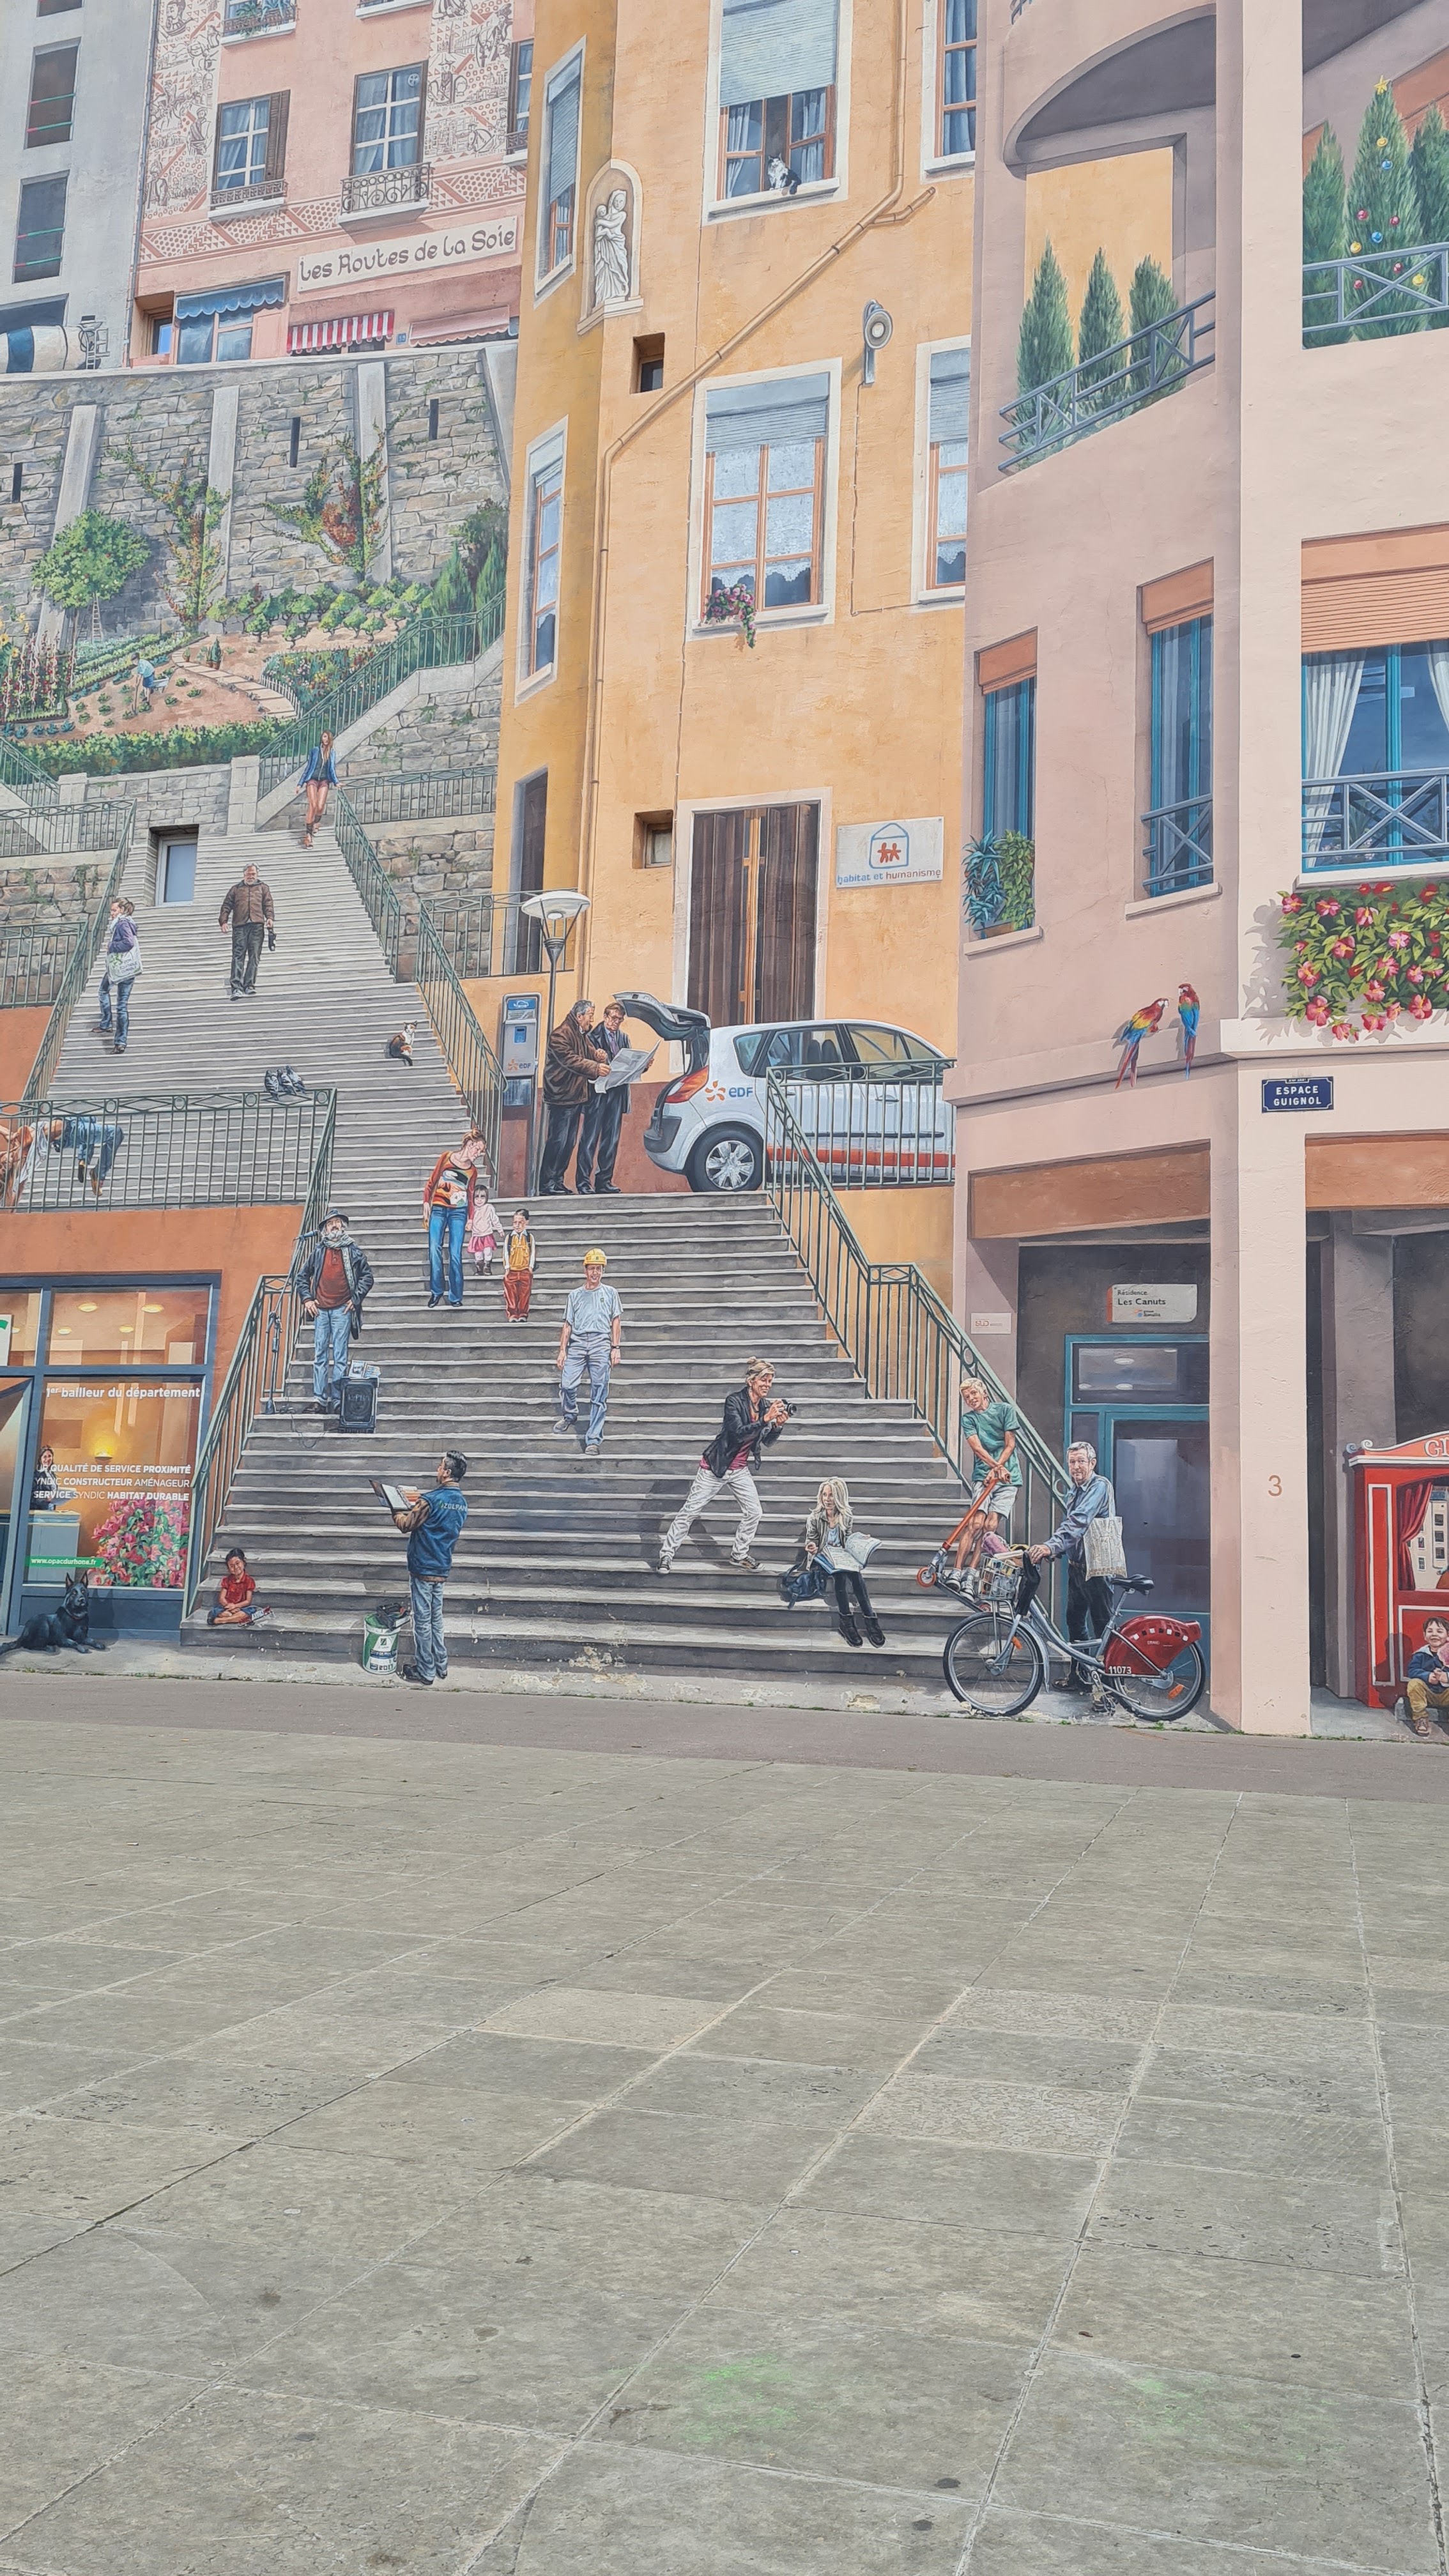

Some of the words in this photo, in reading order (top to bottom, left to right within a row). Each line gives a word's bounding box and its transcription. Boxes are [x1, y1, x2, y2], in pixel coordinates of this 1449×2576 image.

[300, 260, 332, 281] Les
[338, 248, 409, 275] Routes
[415, 240, 438, 261] de
[471, 226, 514, 251] Soie
[838, 874, 871, 883] habitat
[885, 869, 940, 880] humanisme
[1276, 1085, 1319, 1095] ESPACE
[1273, 1096, 1322, 1106] GUIGNOL
[61, 1387, 104, 1397] bailleur
[108, 1387, 123, 1397] du
[126, 1387, 200, 1399] département
[50, 1463, 88, 1472] QUALITÉ
[105, 1464, 141, 1473] SERVICE
[143, 1464, 191, 1474] PROXIMITÉ
[64, 1477, 132, 1486] CONSTRUCTEUR
[134, 1477, 190, 1488] AMÉNAGEUR
[1268, 1475, 1282, 1496] 3
[73, 1491, 105, 1499] SYNDIC
[107, 1491, 145, 1499] HABITAT
[146, 1492, 189, 1501] DURABLE
[1108, 1666, 1131, 1674] 11073
